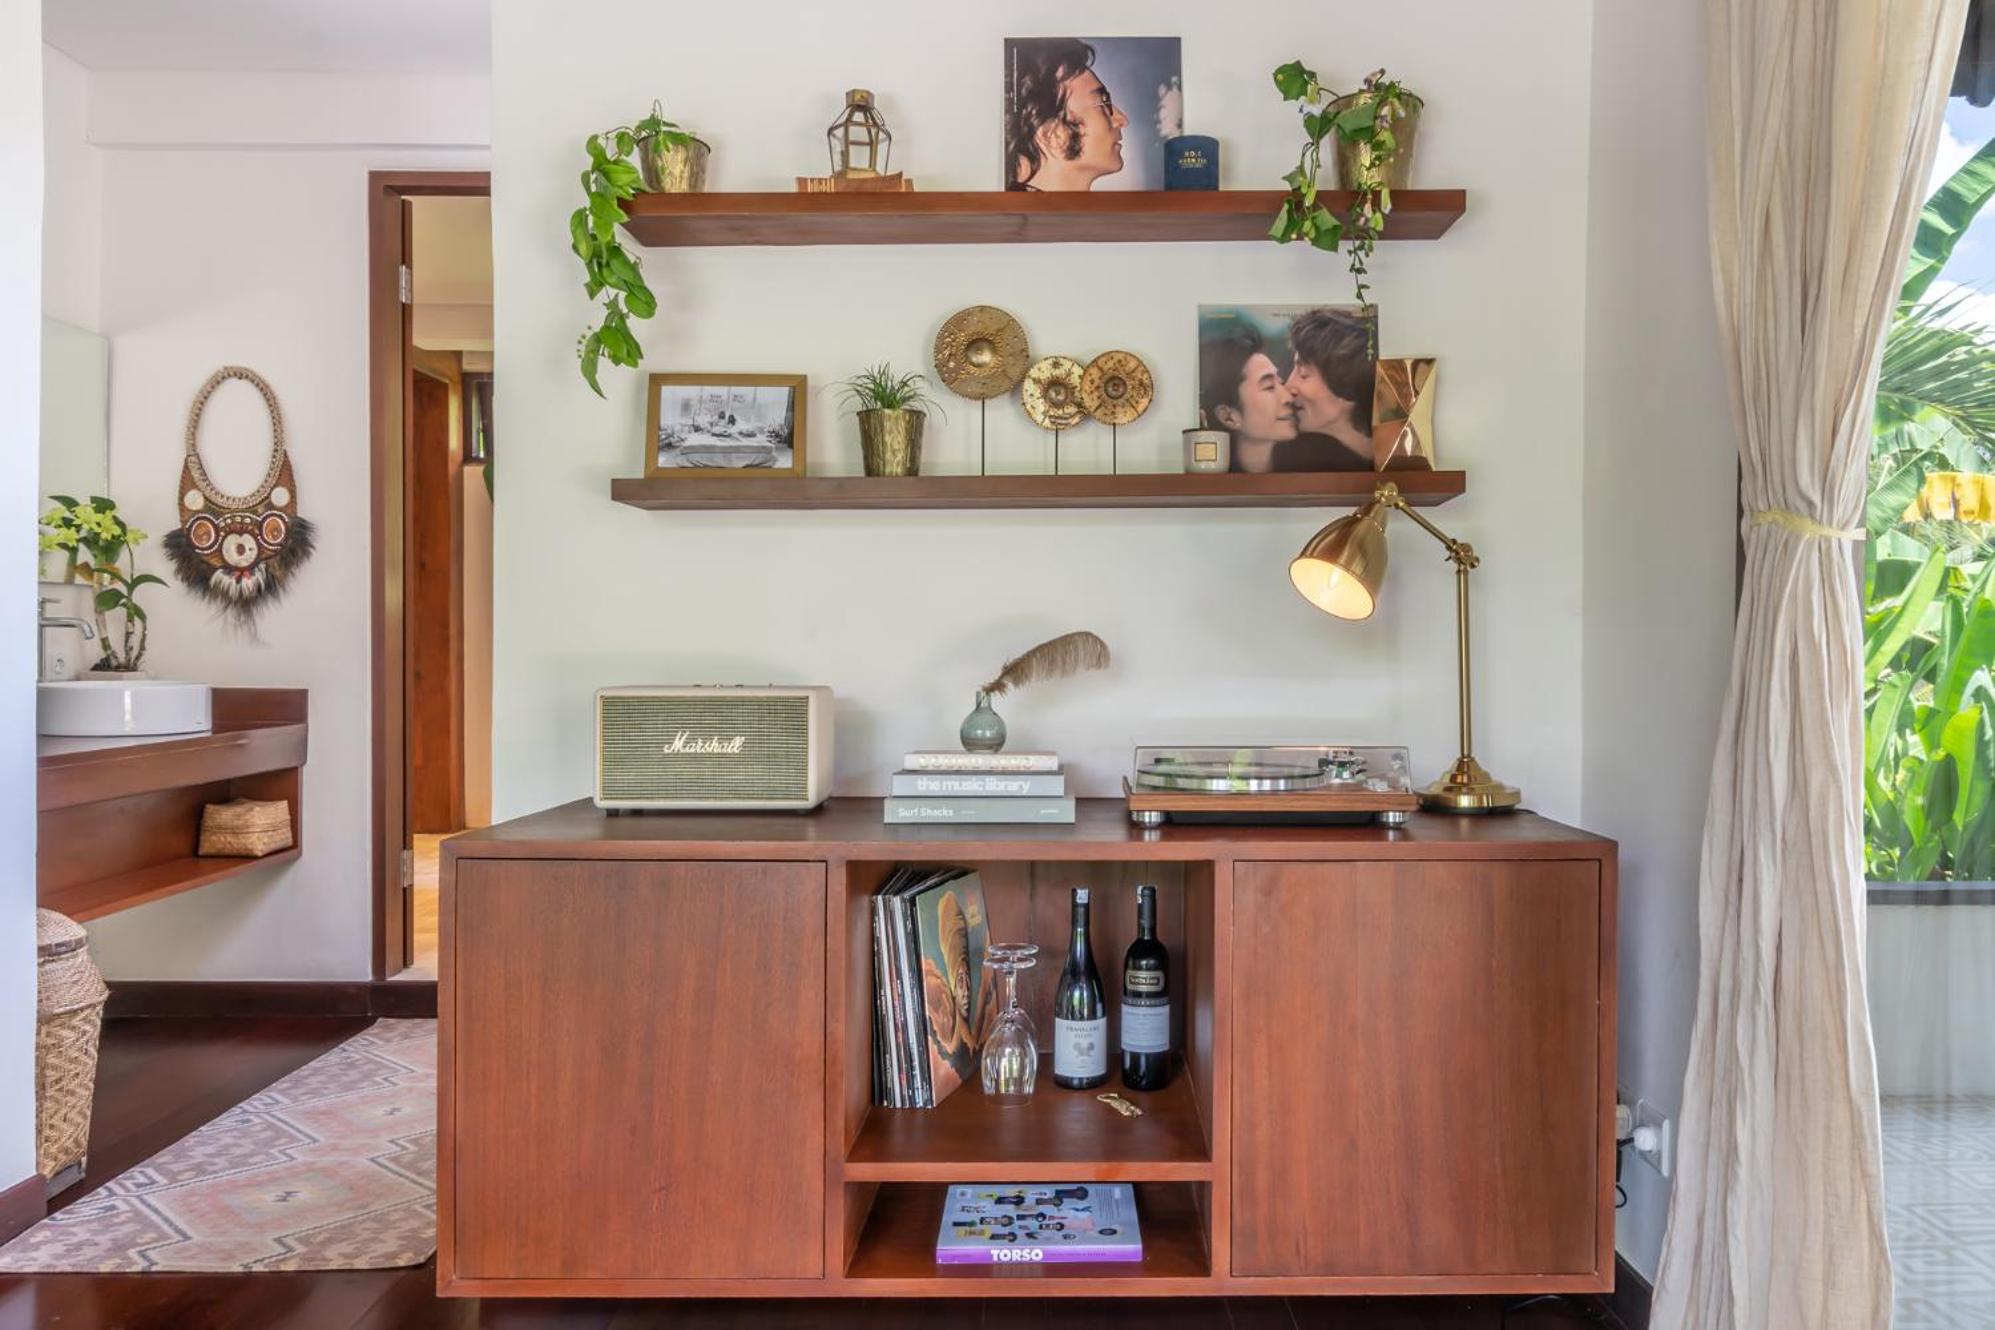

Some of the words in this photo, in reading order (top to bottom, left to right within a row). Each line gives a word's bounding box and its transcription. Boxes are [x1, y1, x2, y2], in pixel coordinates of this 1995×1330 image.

[664, 731, 745, 754] Marshall
[917, 778, 940, 791] the
[942, 778, 984, 791] music
[985, 778, 1031, 794] library
[898, 807, 918, 817] Surf
[920, 807, 954, 817] Shacks
[990, 1249, 1044, 1262] TORSO
